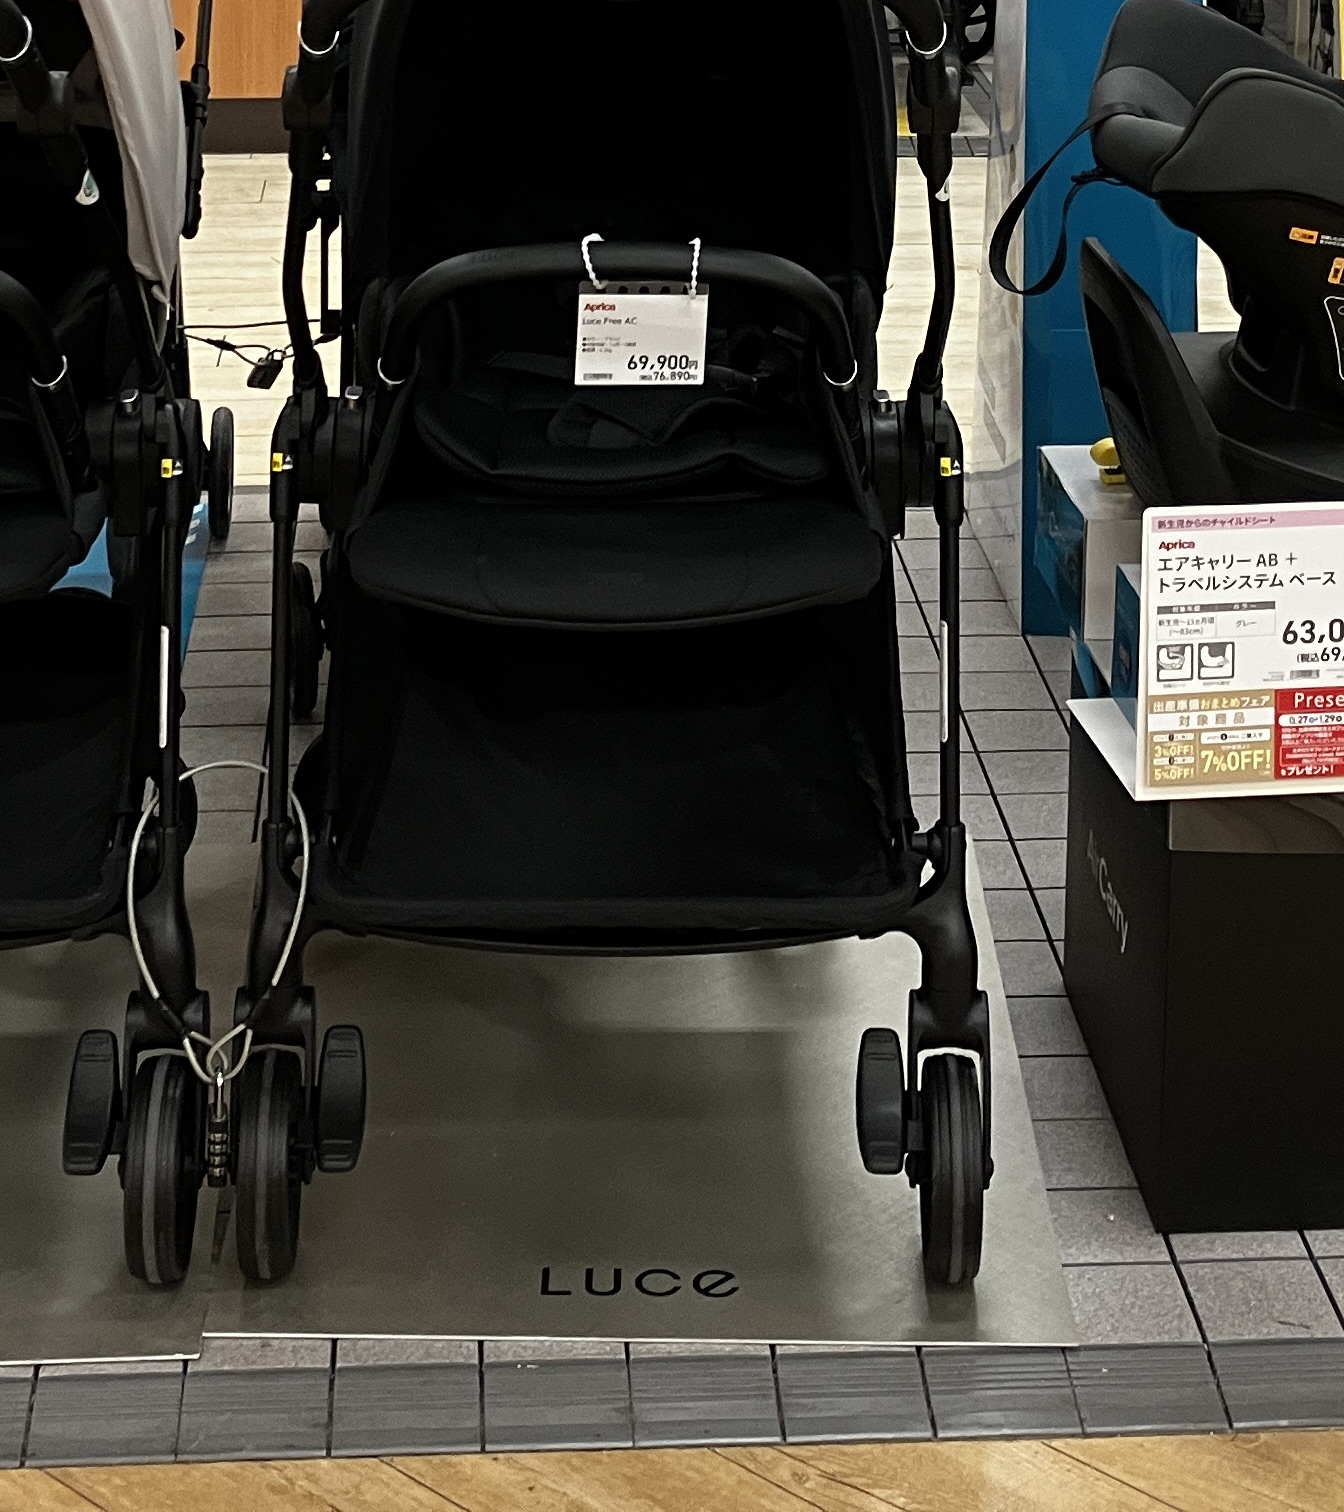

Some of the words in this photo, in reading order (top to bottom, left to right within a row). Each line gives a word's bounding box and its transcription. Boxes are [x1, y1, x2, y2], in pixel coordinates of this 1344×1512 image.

[582, 302, 616, 313] Aprica
[627, 354, 699, 371] 69,900円
[1158, 539, 1196, 551] Aprica
[1157, 554, 1252, 572] エアキャリー
[1256, 553, 1279, 568] AB
[1158, 573, 1285, 594] トラベルシステム
[1288, 571, 1337, 586] ベース
[1201, 748, 1272, 774] 7%OFF!
